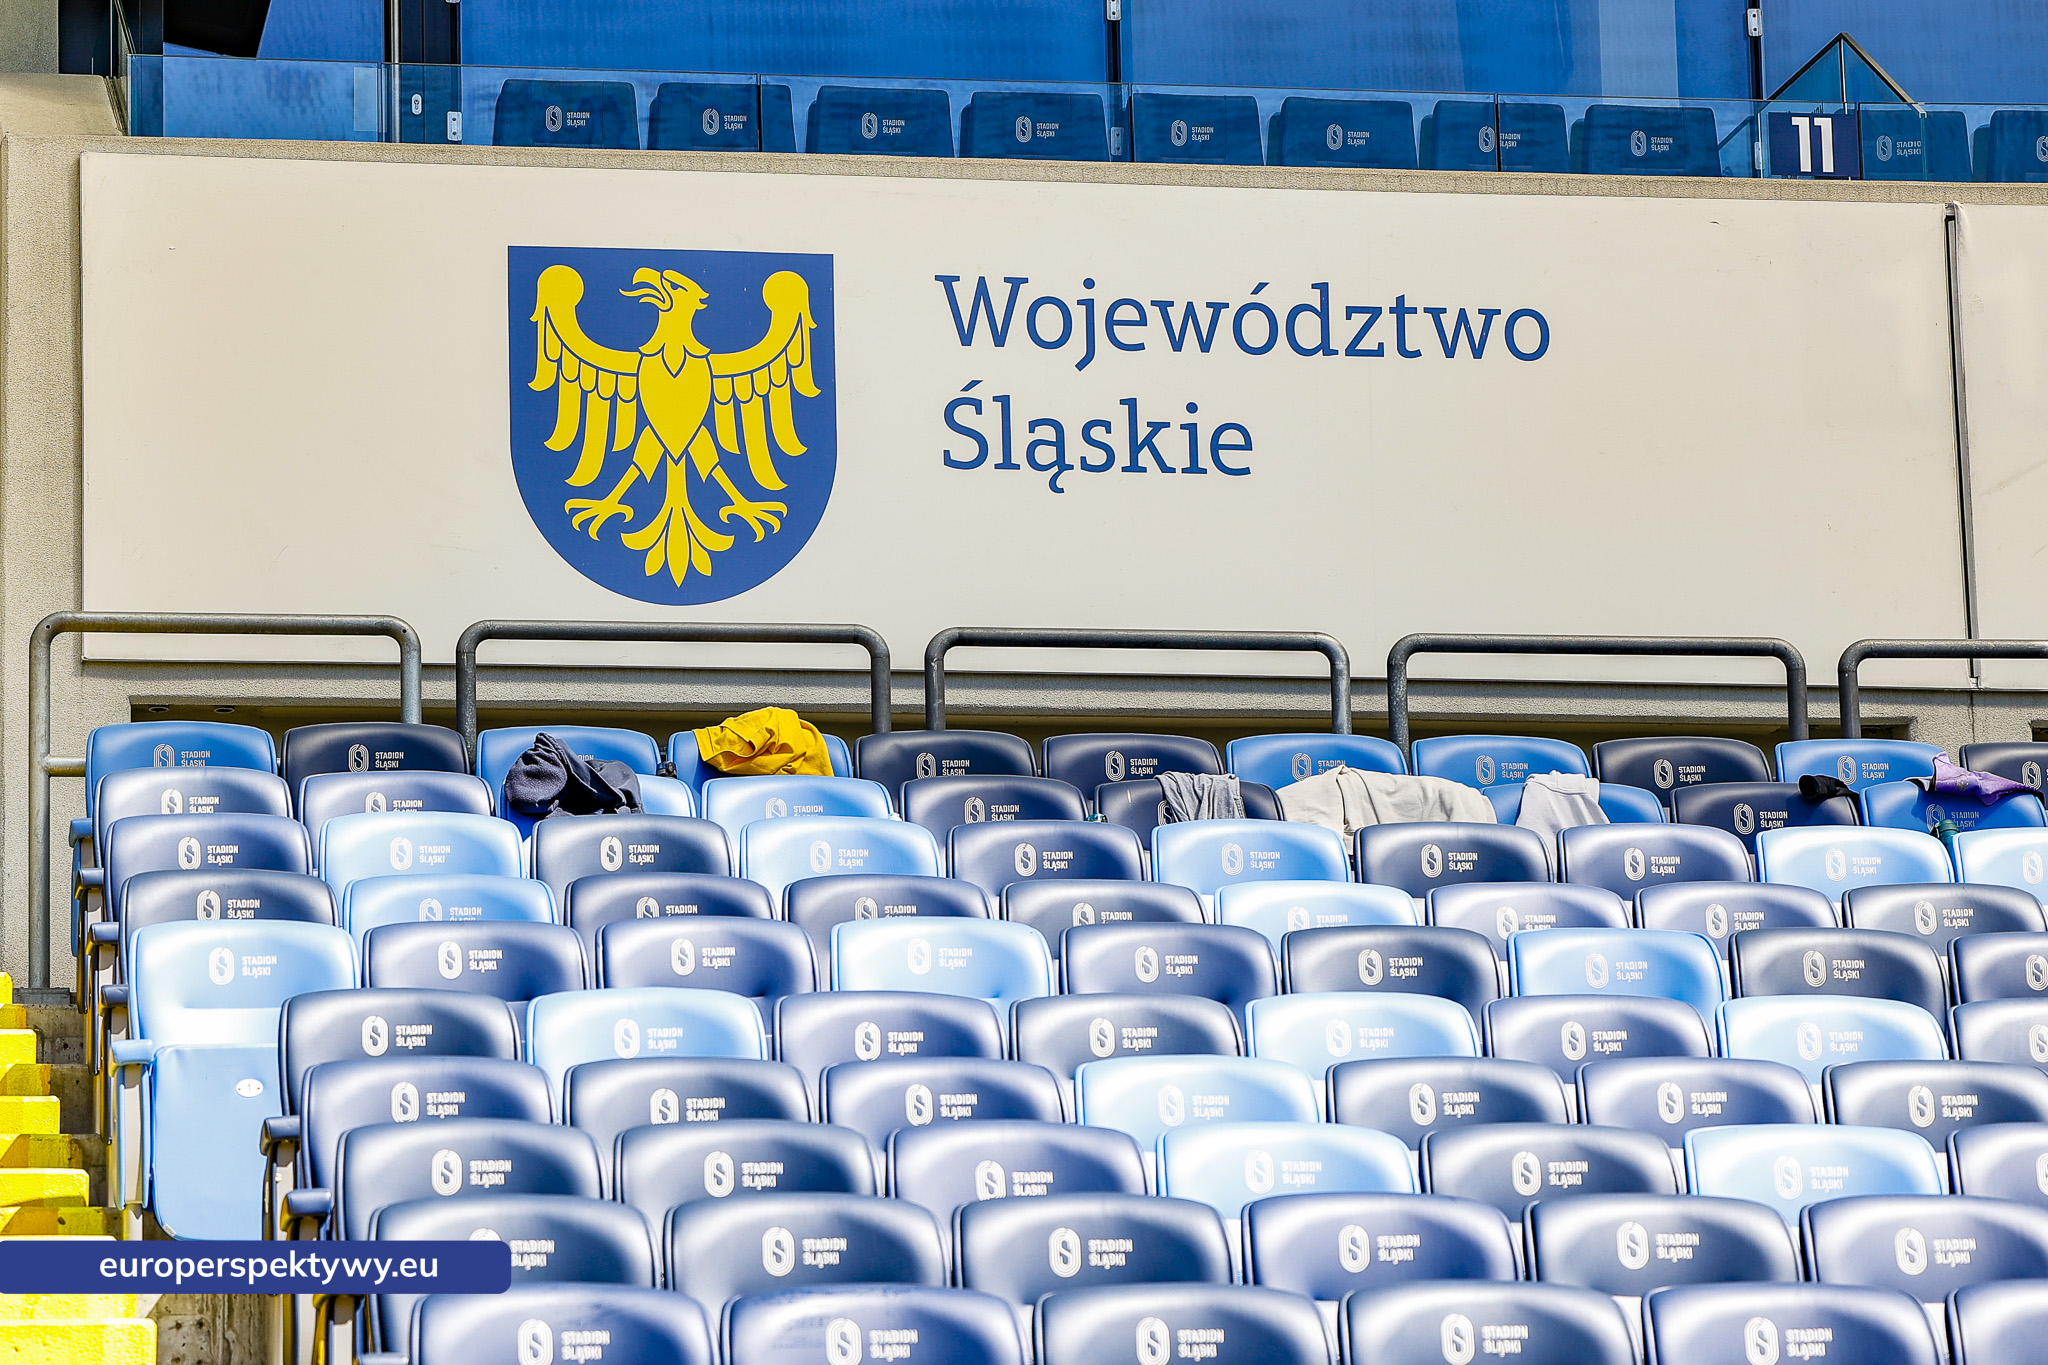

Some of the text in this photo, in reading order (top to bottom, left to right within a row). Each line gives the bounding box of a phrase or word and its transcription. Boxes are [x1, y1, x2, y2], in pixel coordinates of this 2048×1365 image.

[1650, 136, 1673, 144] STADION
[1790, 116, 1834, 172] 11
[934, 274, 1550, 372] Województwo
[942, 380, 1253, 493] Śląskie
[181, 750, 210, 759] STADION
[942, 759, 970, 768] STADION
[1130, 758, 1158, 766] STADION
[1318, 760, 1345, 768] STADION
[1501, 763, 1529, 771] STADION
[1862, 763, 1889, 771] STADION
[1678, 765, 1706, 773] STADION
[189, 796, 219, 804] STADION
[393, 800, 422, 808] STADION
[793, 805, 823, 813] STADION
[991, 804, 1019, 812] STADION
[1760, 810, 1788, 819] STADION
[207, 845, 238, 854] STADION
[419, 846, 450, 854] STADION
[629, 844, 660, 853] STADION
[838, 848, 869, 857] STADION
[1043, 851, 1074, 860] STADION
[1250, 851, 1280, 860] STADION
[1448, 852, 1478, 860] STADION
[1651, 856, 1680, 865] STADION
[1852, 857, 1881, 865] STADION
[228, 899, 260, 908] STADION
[450, 907, 482, 916] STADION
[666, 905, 698, 914] STADION
[884, 905, 917, 914] STADION
[1942, 908, 1974, 917] STADION
[1101, 911, 1132, 920] STADION
[1316, 914, 1348, 923] STADION
[1525, 914, 1557, 923] STADION
[1734, 912, 1764, 921] STADION
[469, 950, 503, 959] STADION
[702, 947, 735, 957] STADION
[938, 948, 972, 957] STADION
[242, 956, 276, 965] STADION
[1165, 955, 1198, 965] STADION
[1389, 957, 1423, 966] STADION
[1615, 960, 1648, 970] STADION
[1832, 959, 1865, 968] STADION
[395, 1024, 432, 1035] STADION
[647, 1028, 683, 1038] STADION
[1122, 1027, 1158, 1038] STADION
[1359, 1027, 1394, 1037] STADION
[888, 1031, 924, 1042] STADION
[1592, 1030, 1627, 1040] STADION
[1829, 1031, 1863, 1041] STADION
[426, 1092, 465, 1104] STADION
[940, 1093, 978, 1105] STADION
[1192, 1095, 1229, 1106] STADION
[1442, 1092, 1480, 1104] STADION
[1691, 1092, 1727, 1103] STADION
[1941, 1095, 1978, 1106] STADION
[686, 1098, 726, 1109] STADION
[470, 1160, 512, 1173] STADION
[741, 1162, 784, 1175] STADION
[1281, 1161, 1322, 1173] STADION
[1548, 1161, 1589, 1174] STADION
[1810, 1166, 1849, 1178] STADION
[1012, 1171, 1054, 1184] STADION
[803, 1238, 847, 1251] STADION
[1377, 1235, 1420, 1248] STADION
[1656, 1233, 1699, 1246] STADION
[1933, 1238, 1977, 1251] STADION
[510, 1239, 555, 1253] STADION
[1088, 1238, 1133, 1252] STADION
[870, 1329, 918, 1344] STADION
[1177, 1329, 1225, 1344] STADION
[1481, 1325, 1528, 1339] STADION
[1786, 1328, 1833, 1342] STADION
[562, 1330, 610, 1345] STADION
